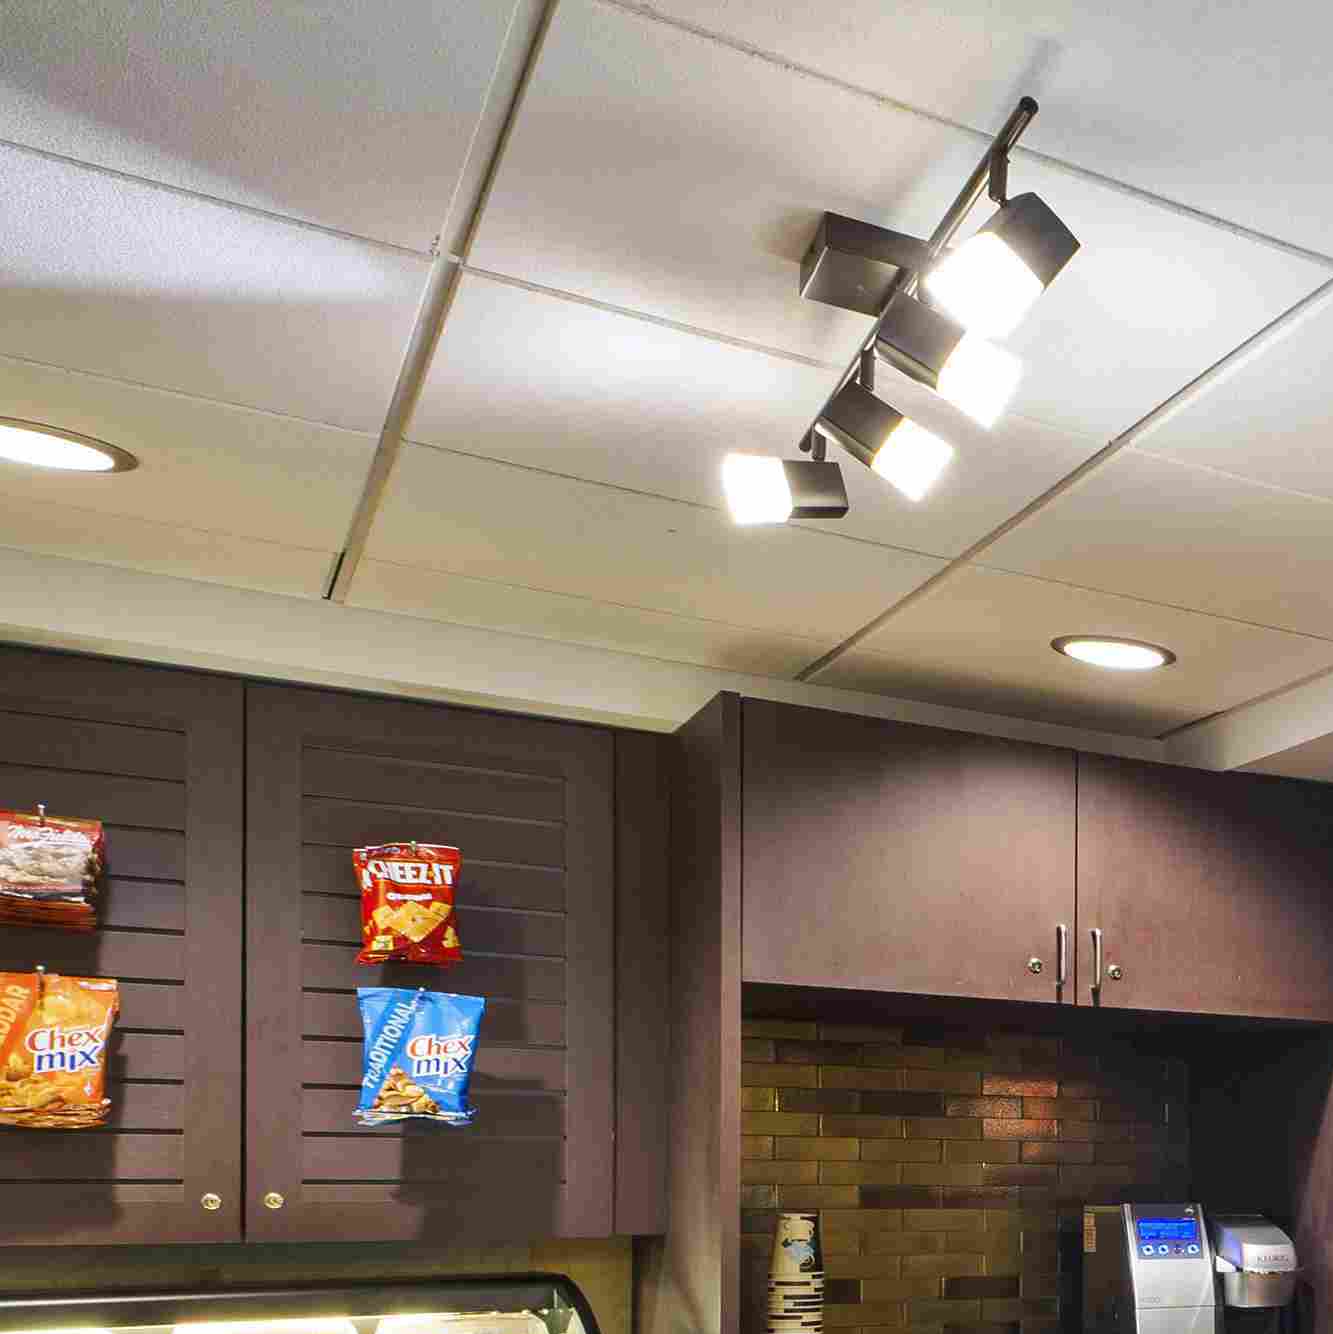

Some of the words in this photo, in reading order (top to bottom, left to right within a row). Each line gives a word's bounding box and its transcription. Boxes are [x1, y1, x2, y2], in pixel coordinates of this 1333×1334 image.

[27, 1028, 104, 1052] Chex
[364, 1001, 418, 1092] TRADITIONAL
[407, 1034, 476, 1059] Chex
